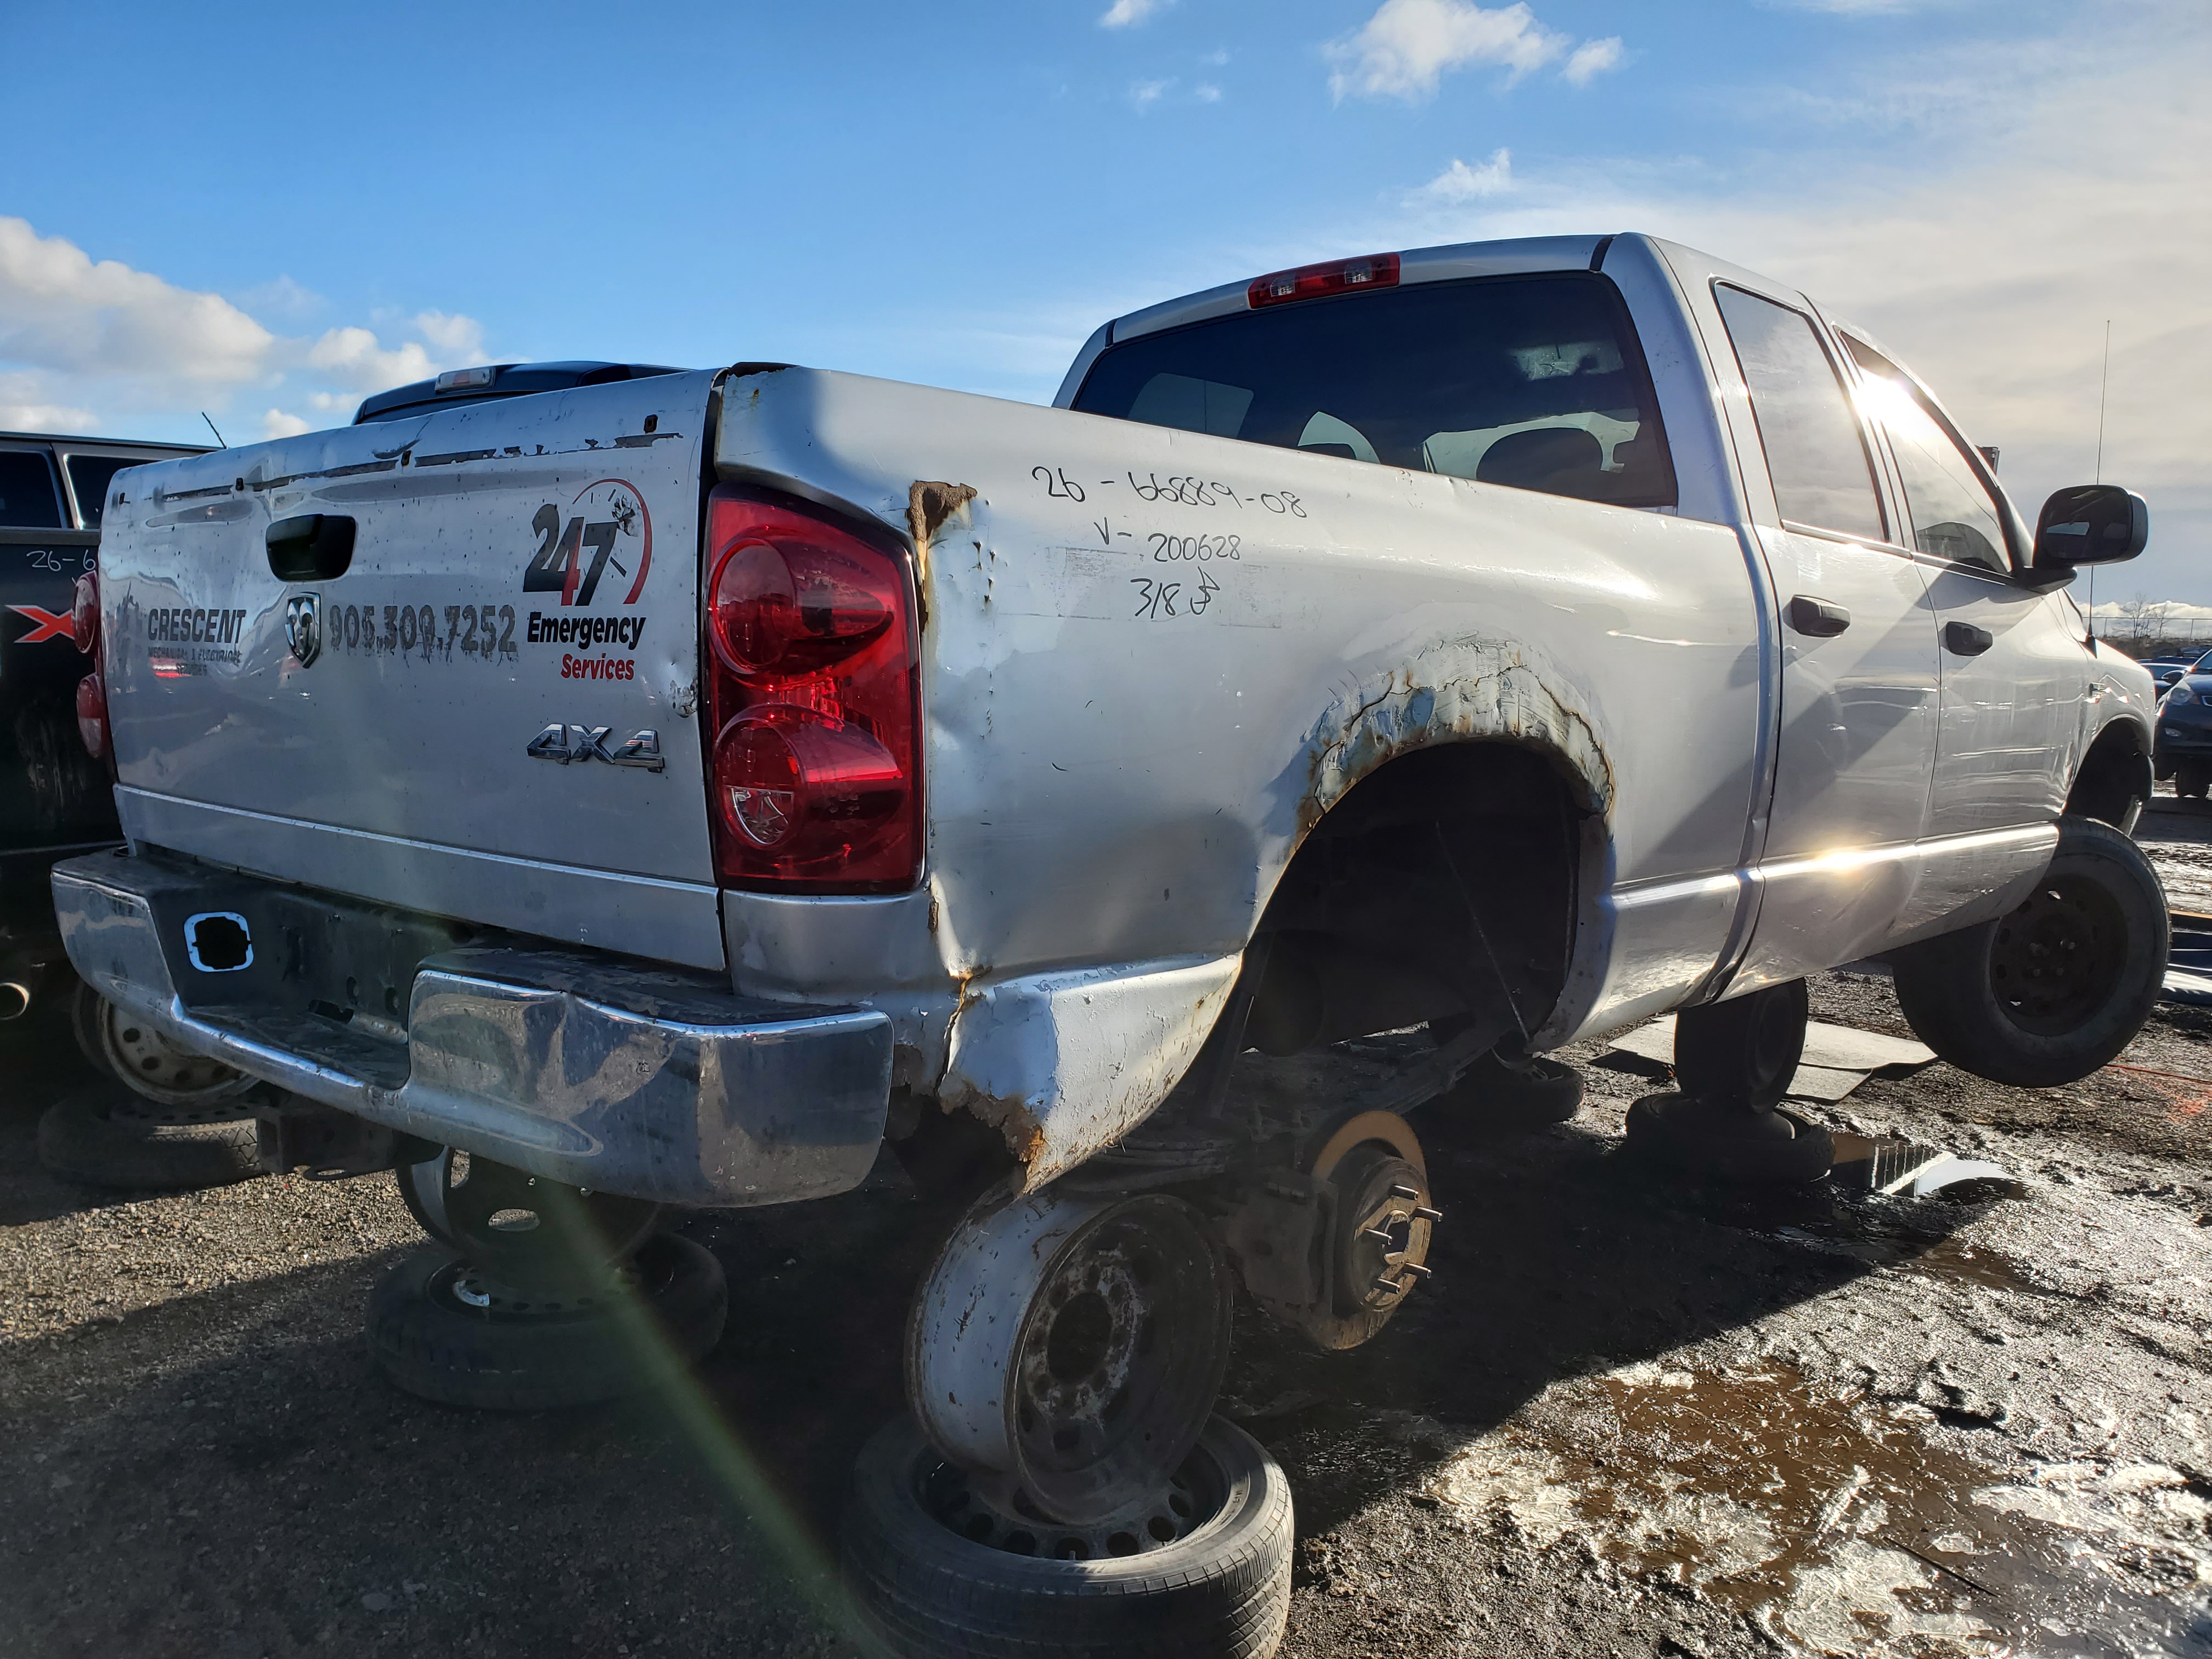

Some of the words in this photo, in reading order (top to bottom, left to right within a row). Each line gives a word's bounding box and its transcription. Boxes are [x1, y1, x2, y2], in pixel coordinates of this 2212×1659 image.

[522, 503, 618, 607] 247
[1148, 533, 1241, 562] 200628
[148, 608, 246, 644] CRESCENT
[527, 611, 646, 650] Emergency
[561, 653, 635, 680] Services
[526, 723, 665, 772] 4X4
